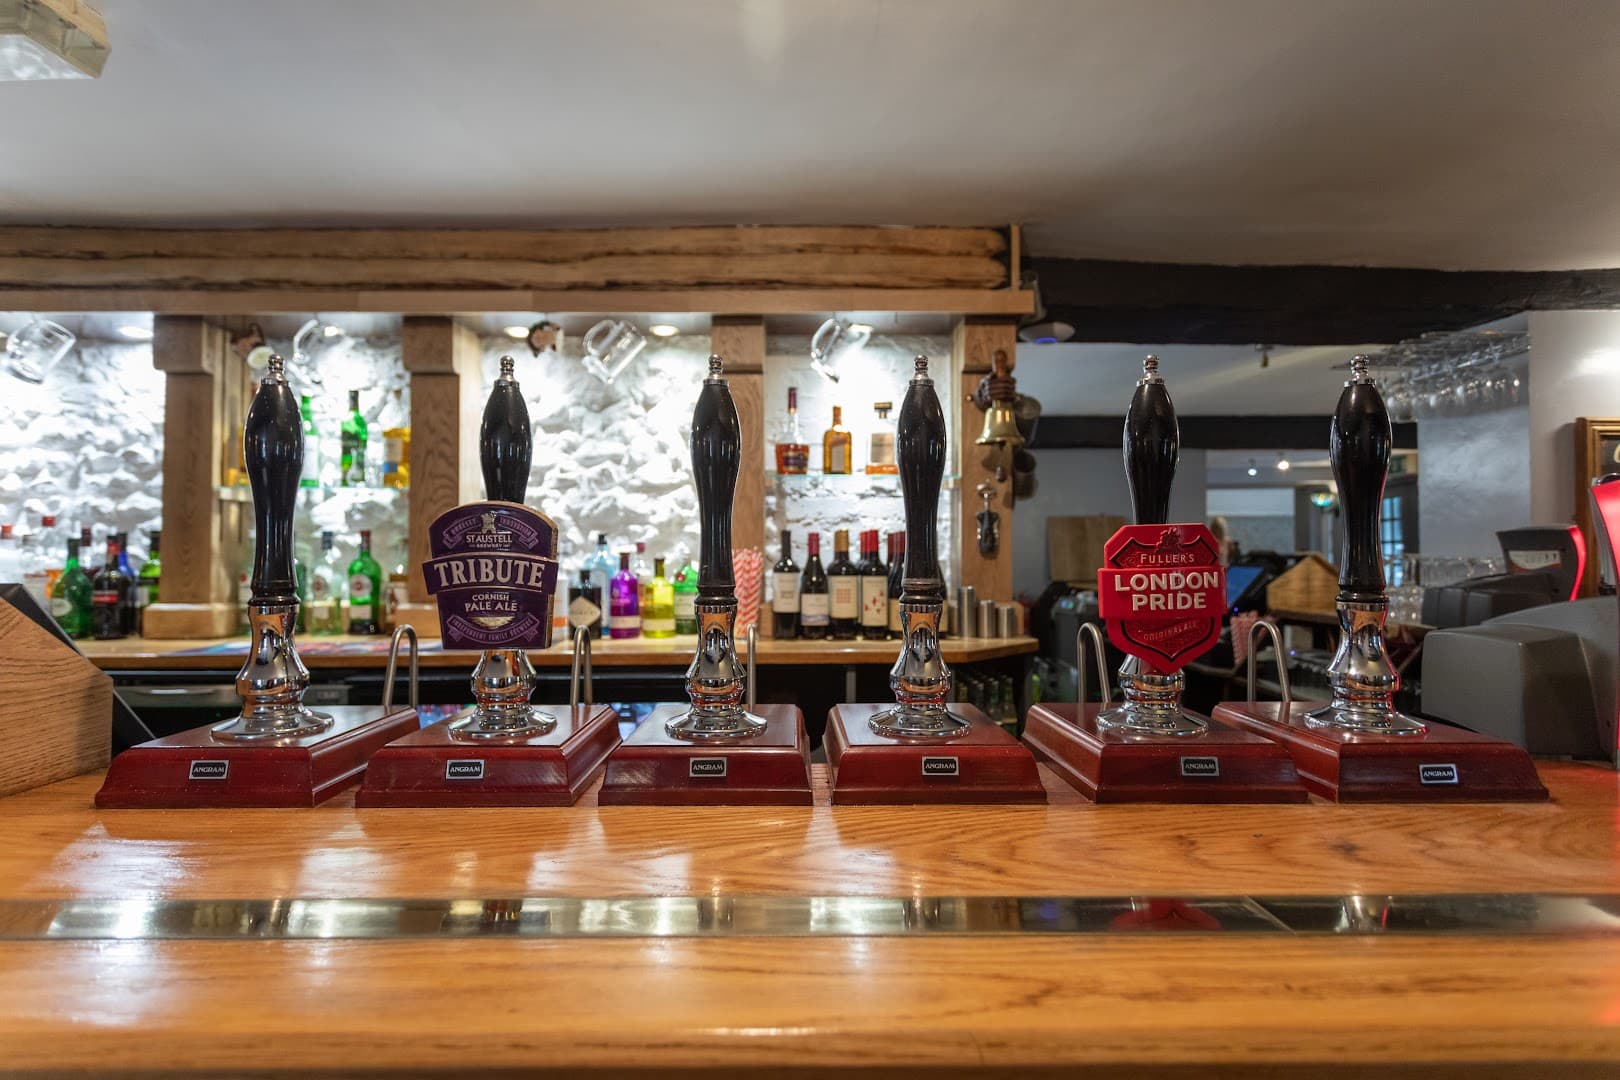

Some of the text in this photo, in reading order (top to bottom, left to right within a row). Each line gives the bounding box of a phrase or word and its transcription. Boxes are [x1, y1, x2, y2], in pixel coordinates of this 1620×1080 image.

[475, 535, 513, 543] AUSTELL
[1140, 553, 1195, 564] FULLER'S
[433, 558, 546, 588] TRIBUTE
[1114, 571, 1219, 592] LONDON
[465, 601, 518, 612] PALE ALE
[1132, 592, 1207, 612] PRIDE
[693, 763, 724, 771] ANGRAM
